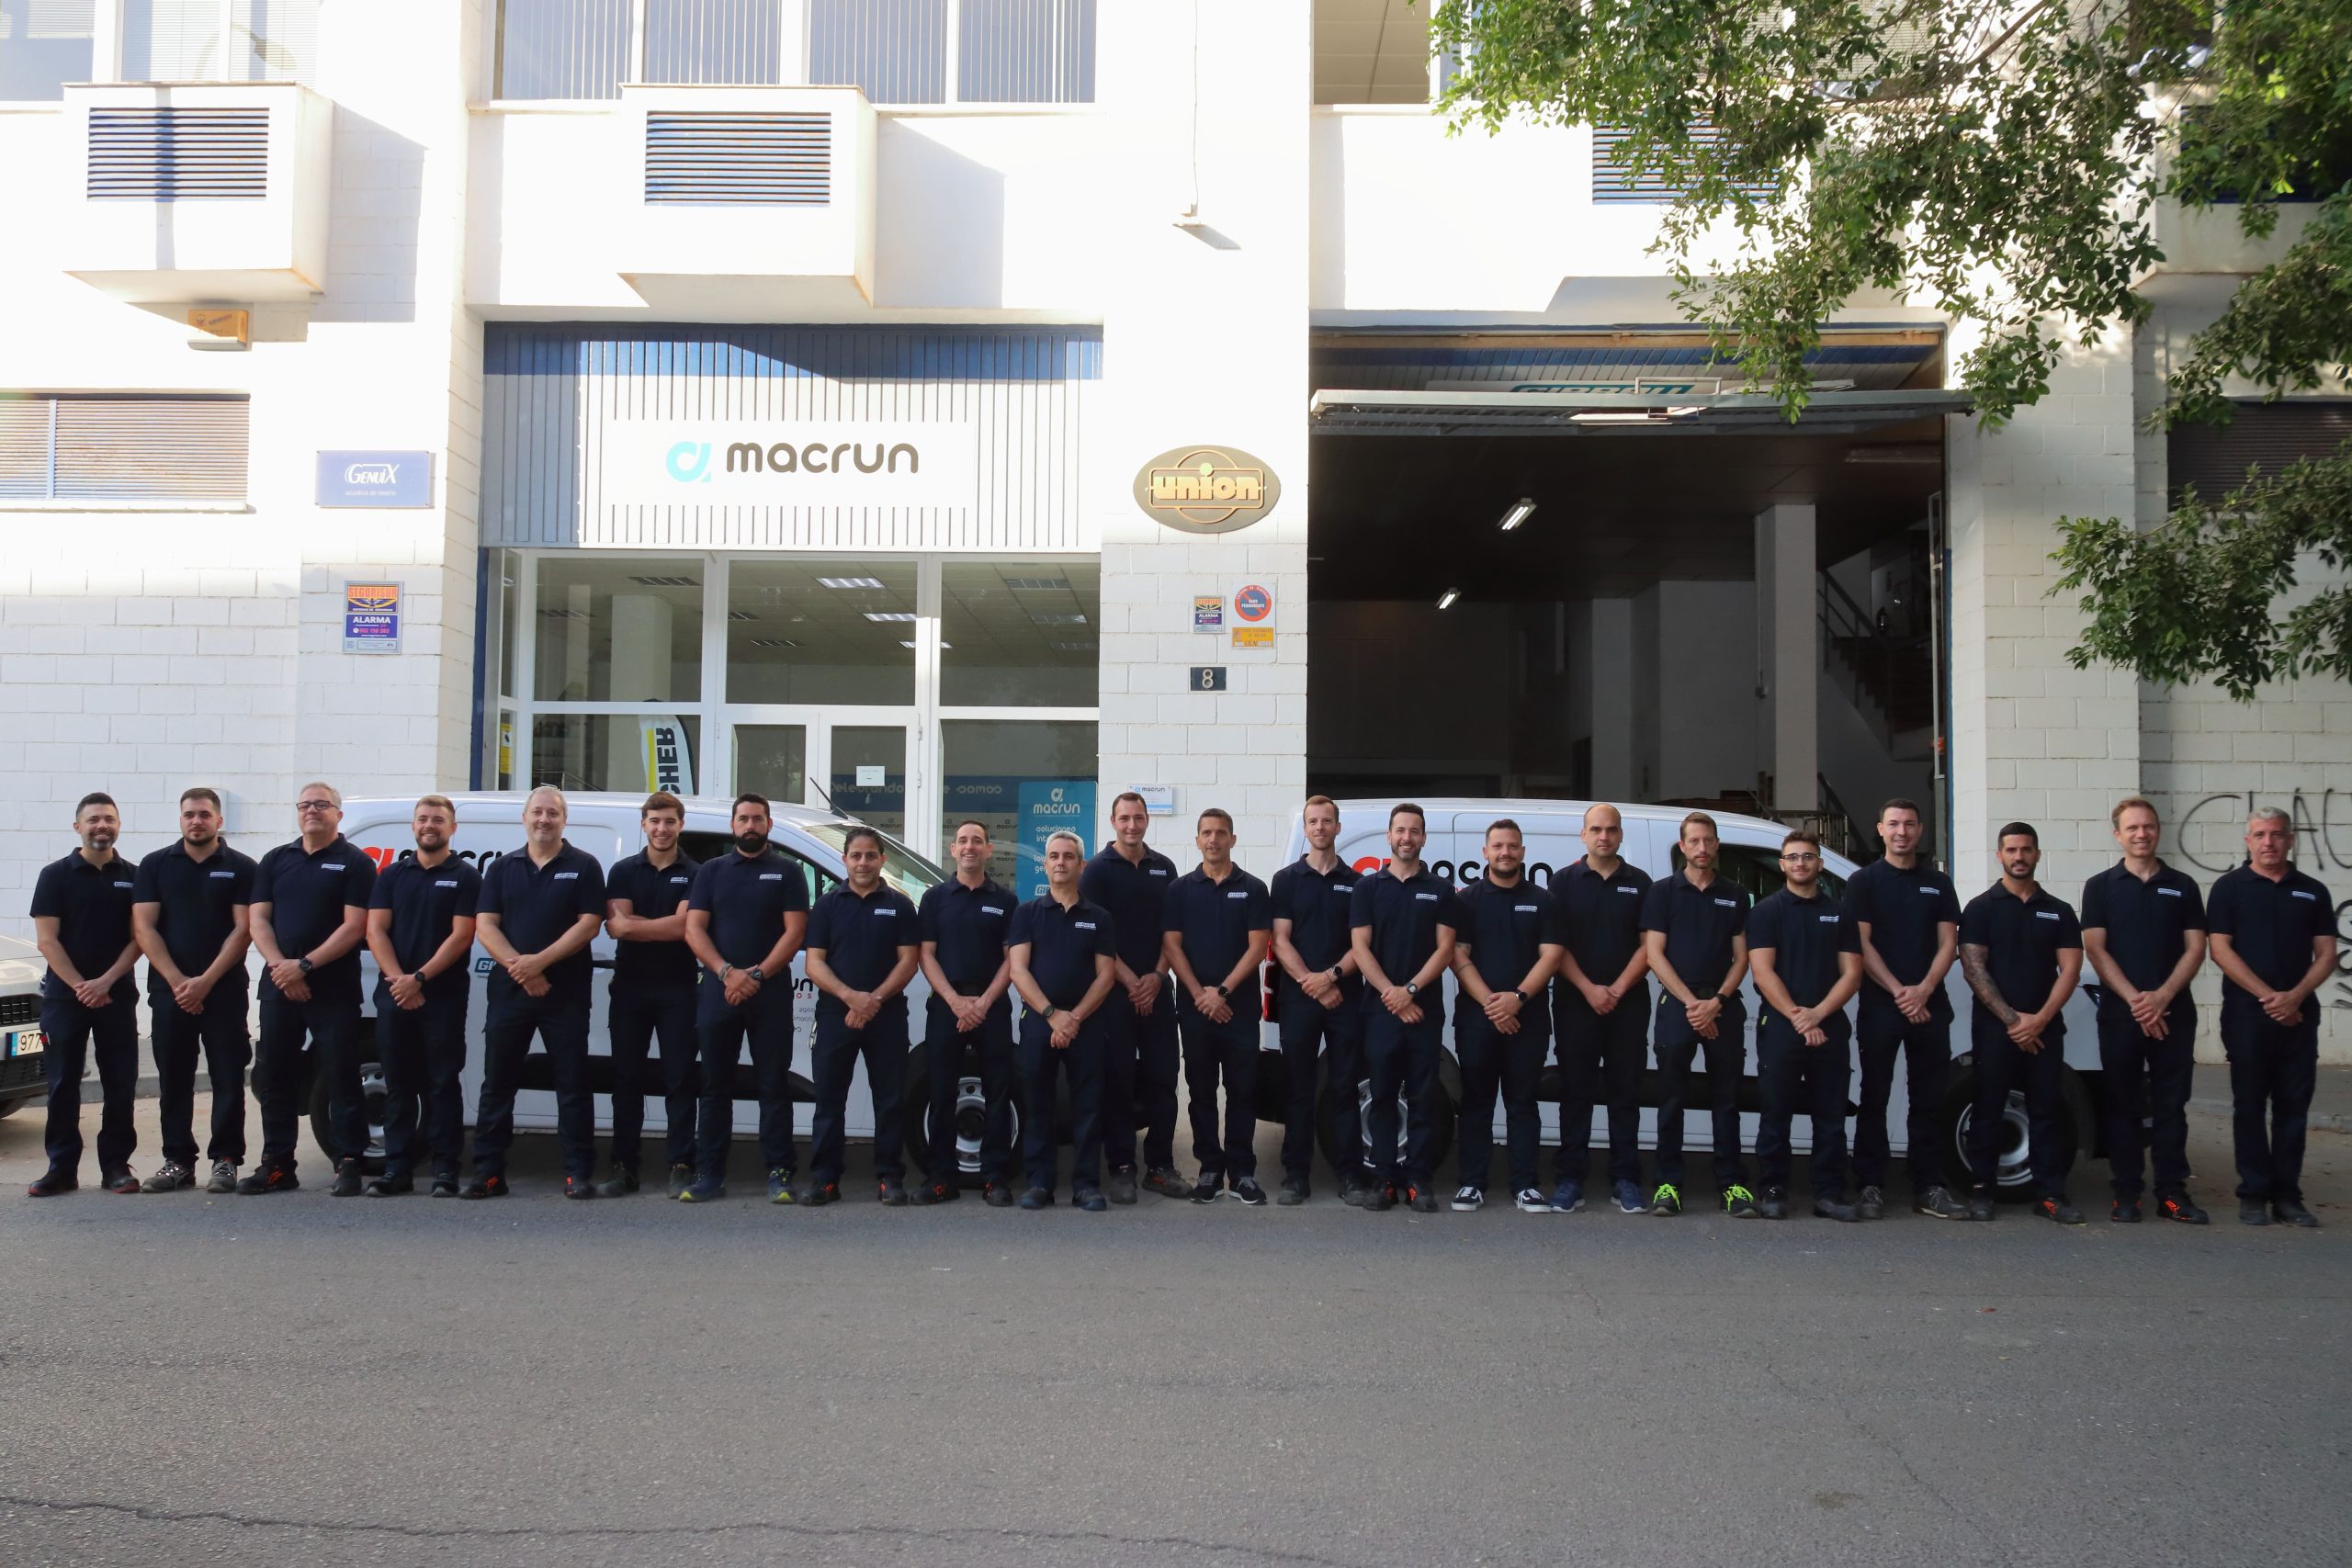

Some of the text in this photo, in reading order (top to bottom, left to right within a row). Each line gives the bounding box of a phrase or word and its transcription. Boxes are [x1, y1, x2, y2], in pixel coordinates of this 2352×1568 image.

[726, 442, 919, 474] macrun
[1153, 462, 1261, 500] union
[353, 615, 391, 624] ALARMA
[1202, 669, 1214, 689] 8
[1033, 803, 1081, 815] macrun
